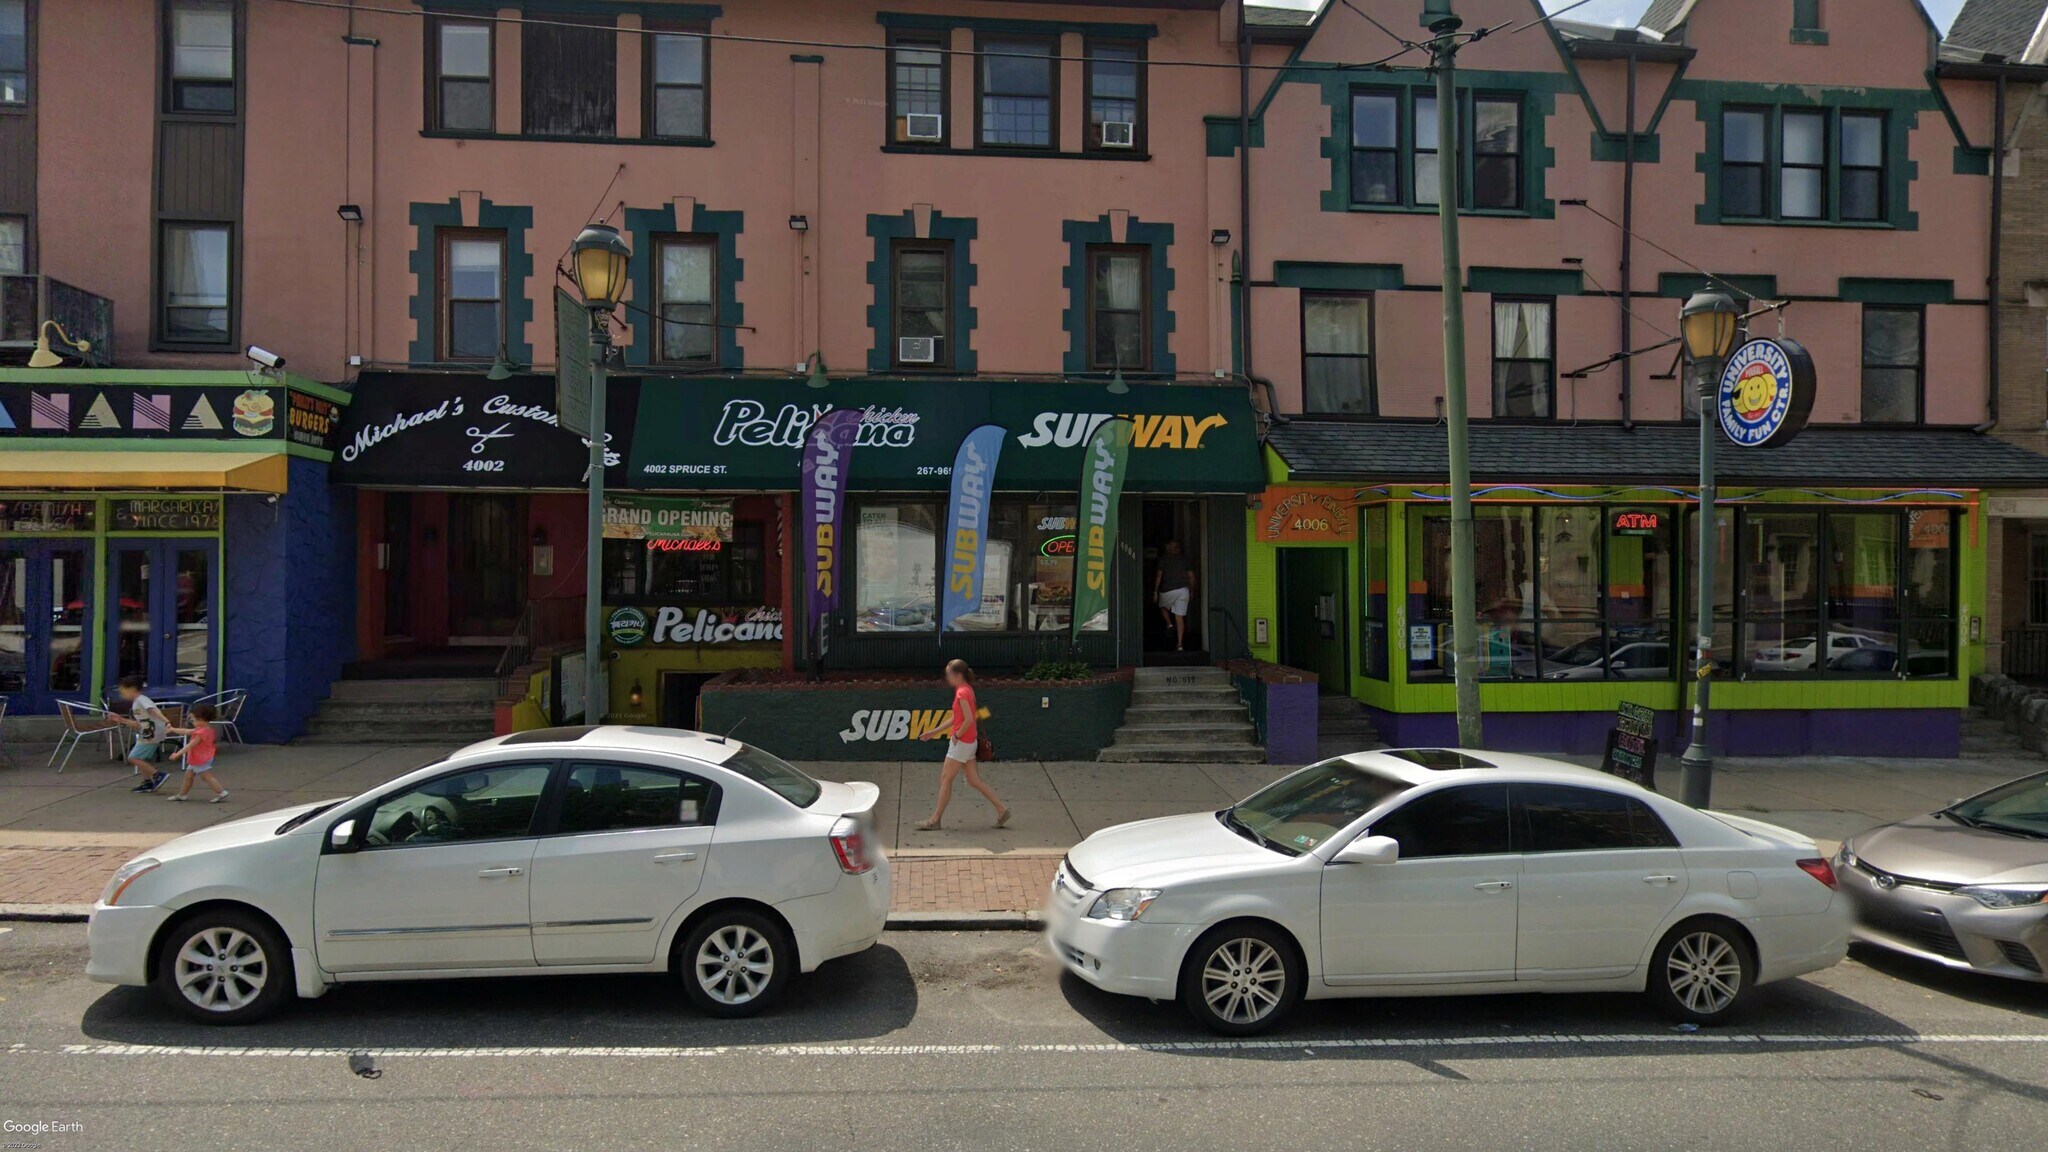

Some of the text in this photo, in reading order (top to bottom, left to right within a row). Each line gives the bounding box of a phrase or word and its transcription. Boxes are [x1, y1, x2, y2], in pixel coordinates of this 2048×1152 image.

[1723, 344, 1787, 393] UNIVERSITY
[290, 407, 330, 434] BURGERS
[342, 396, 464, 461] Michael's
[1722, 383, 1789, 441] FAMILY FUN CTR.
[463, 460, 505, 472] 4002
[643, 465, 728, 474] 4002 SPRUCE ST.
[814, 430, 843, 598] SUBWAY
[951, 440, 987, 600] SUBWAY
[1086, 437, 1116, 598] SUBWAY
[1268, 493, 1352, 538] UNIVERSITY PINBALL
[1295, 518, 1329, 530] 4006
[1617, 514, 1657, 528] ATM
[839, 709, 955, 744] SUBWA
